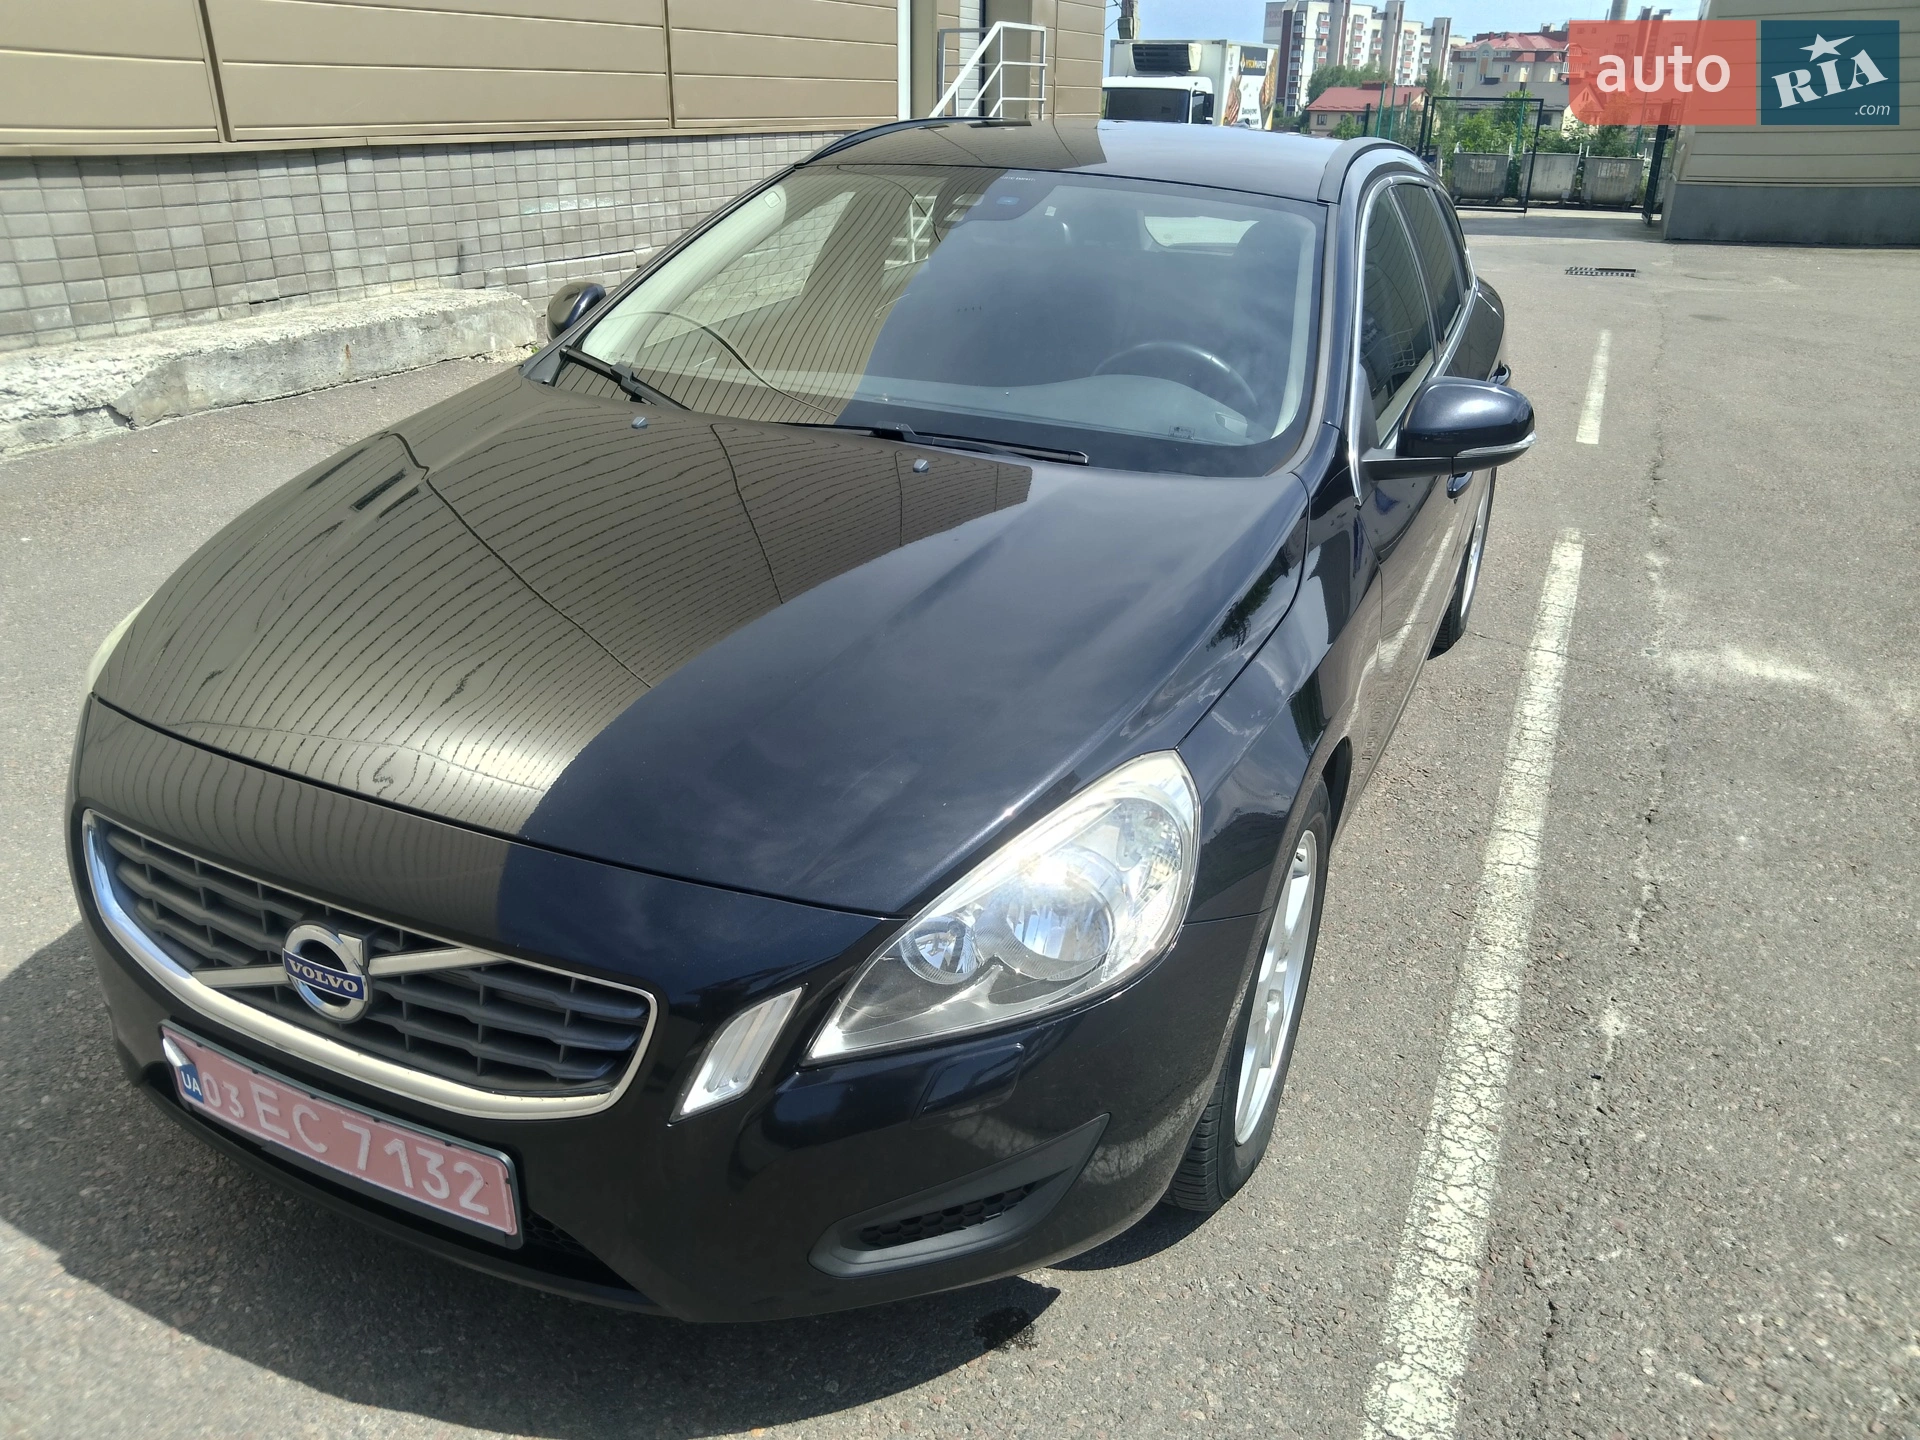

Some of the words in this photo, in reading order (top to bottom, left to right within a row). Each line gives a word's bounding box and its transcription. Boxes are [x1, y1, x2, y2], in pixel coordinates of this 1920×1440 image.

[287, 957, 359, 993] VOLVO
[180, 1070, 203, 1097] UA
[201, 1071, 245, 1118] 03
[248, 1080, 328, 1154] EC
[342, 1120, 490, 1216] 7132
